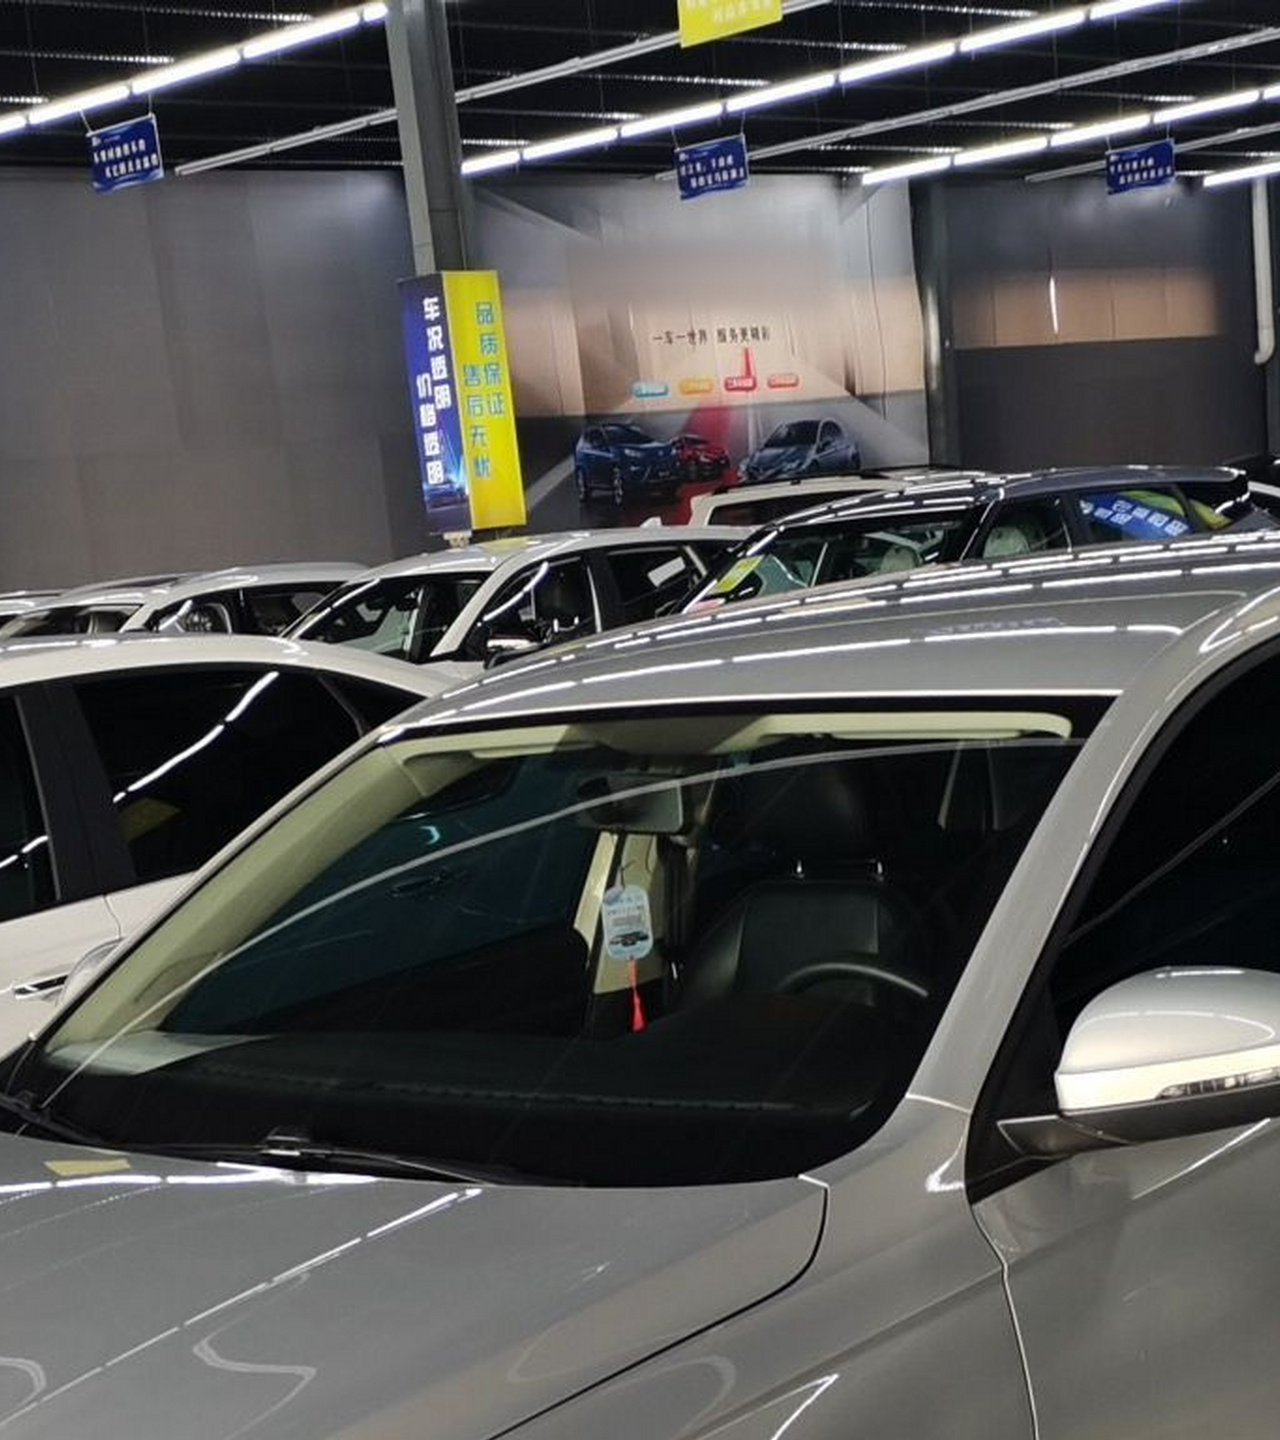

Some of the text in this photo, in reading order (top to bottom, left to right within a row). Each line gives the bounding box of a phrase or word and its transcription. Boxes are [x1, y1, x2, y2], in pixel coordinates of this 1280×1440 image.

[476, 302, 505, 415] 品质保证
[464, 365, 491, 477] 售后无忧
